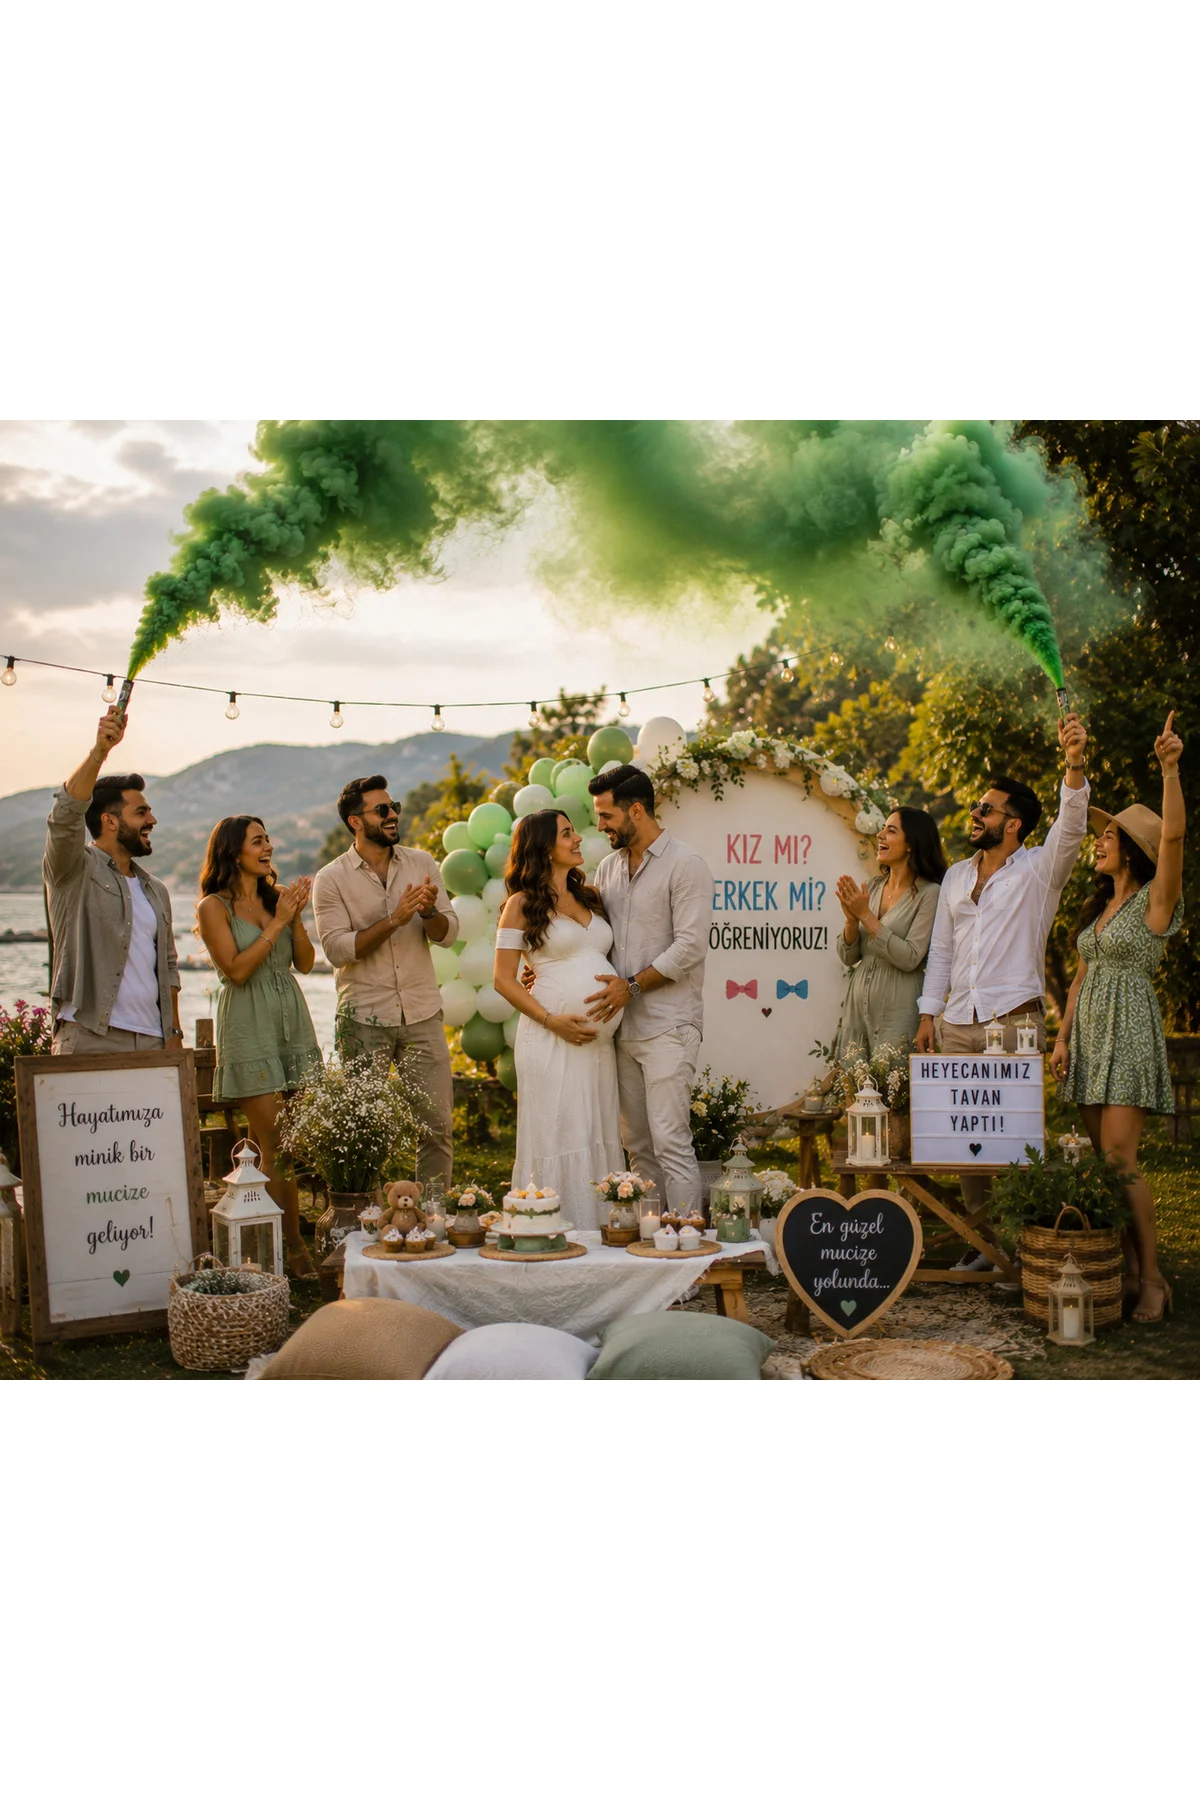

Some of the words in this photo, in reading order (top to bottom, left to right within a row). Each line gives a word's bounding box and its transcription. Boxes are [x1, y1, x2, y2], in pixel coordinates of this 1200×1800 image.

[726, 834, 763, 865] KIZ
[773, 834, 812, 865] MI?
[712, 880, 778, 911] ERKEK
[789, 876, 826, 911] Mİ?
[708, 922, 828, 950] ÖĞRENİYORUZ!
[921, 1062, 1031, 1079] HEYECANIMIZ
[950, 1089, 1001, 1105] TAVAN
[57, 1102, 164, 1134] Hayatımıza
[950, 1115, 1004, 1132] YAPTI!
[75, 1141, 125, 1167] minik
[129, 1140, 155, 1163] bir
[86, 1184, 150, 1205] mucize
[86, 1216, 154, 1255] geliyor!
[809, 1212, 835, 1235] En
[820, 1245, 878, 1267] mucize
[813, 1268, 890, 1297] yolunda...
